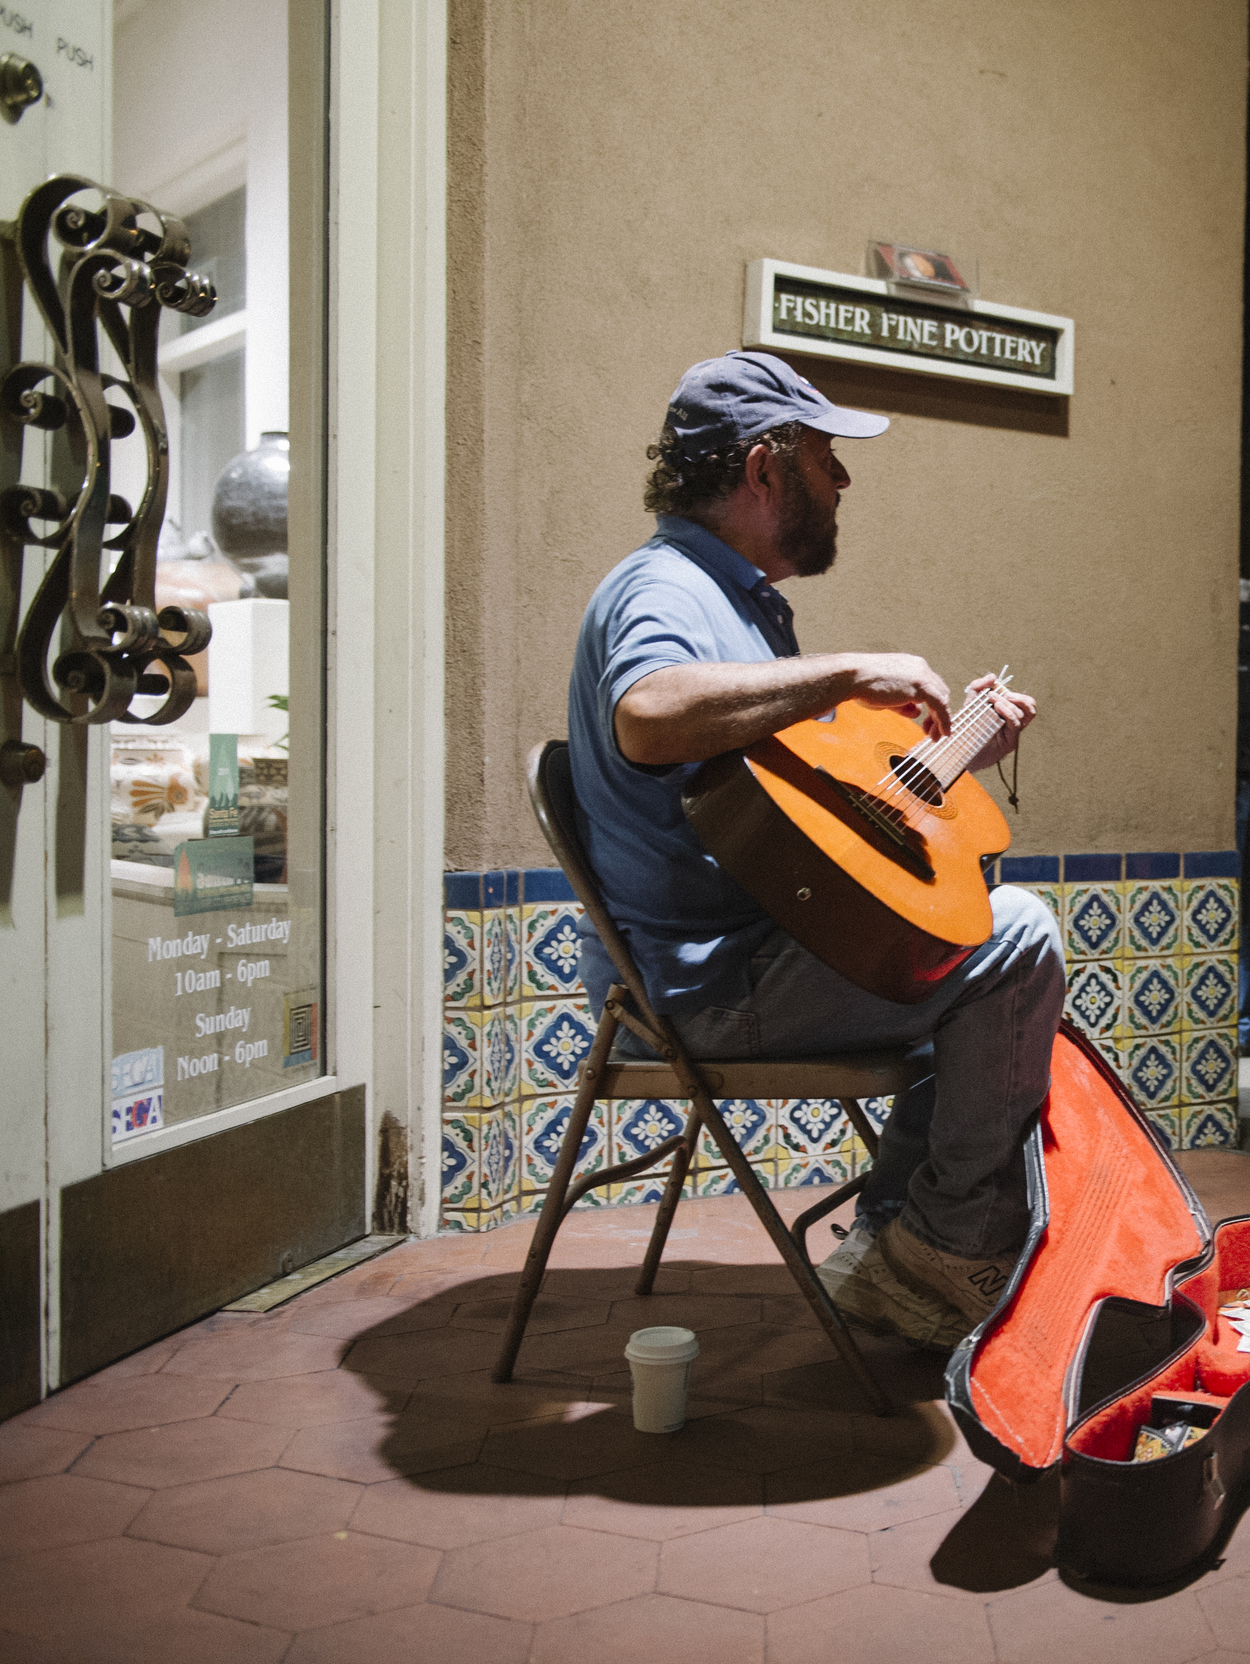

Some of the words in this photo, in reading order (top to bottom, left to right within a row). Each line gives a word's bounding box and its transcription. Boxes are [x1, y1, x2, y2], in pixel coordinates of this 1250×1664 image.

[56, 37, 94, 72] PUSH
[779, 293, 872, 335] FISHER
[881, 312, 939, 346] FINE
[944, 323, 1046, 365] POTTERY
[148, 931, 211, 962] Monday
[227, 918, 292, 948] Saturday
[175, 969, 221, 996] 10am
[237, 959, 270, 987] 6pm
[195, 1006, 252, 1038] Sunday
[177, 1052, 219, 1081] Noon
[235, 1039, 269, 1067] 6pm
[968, 1265, 1009, 1296] N
